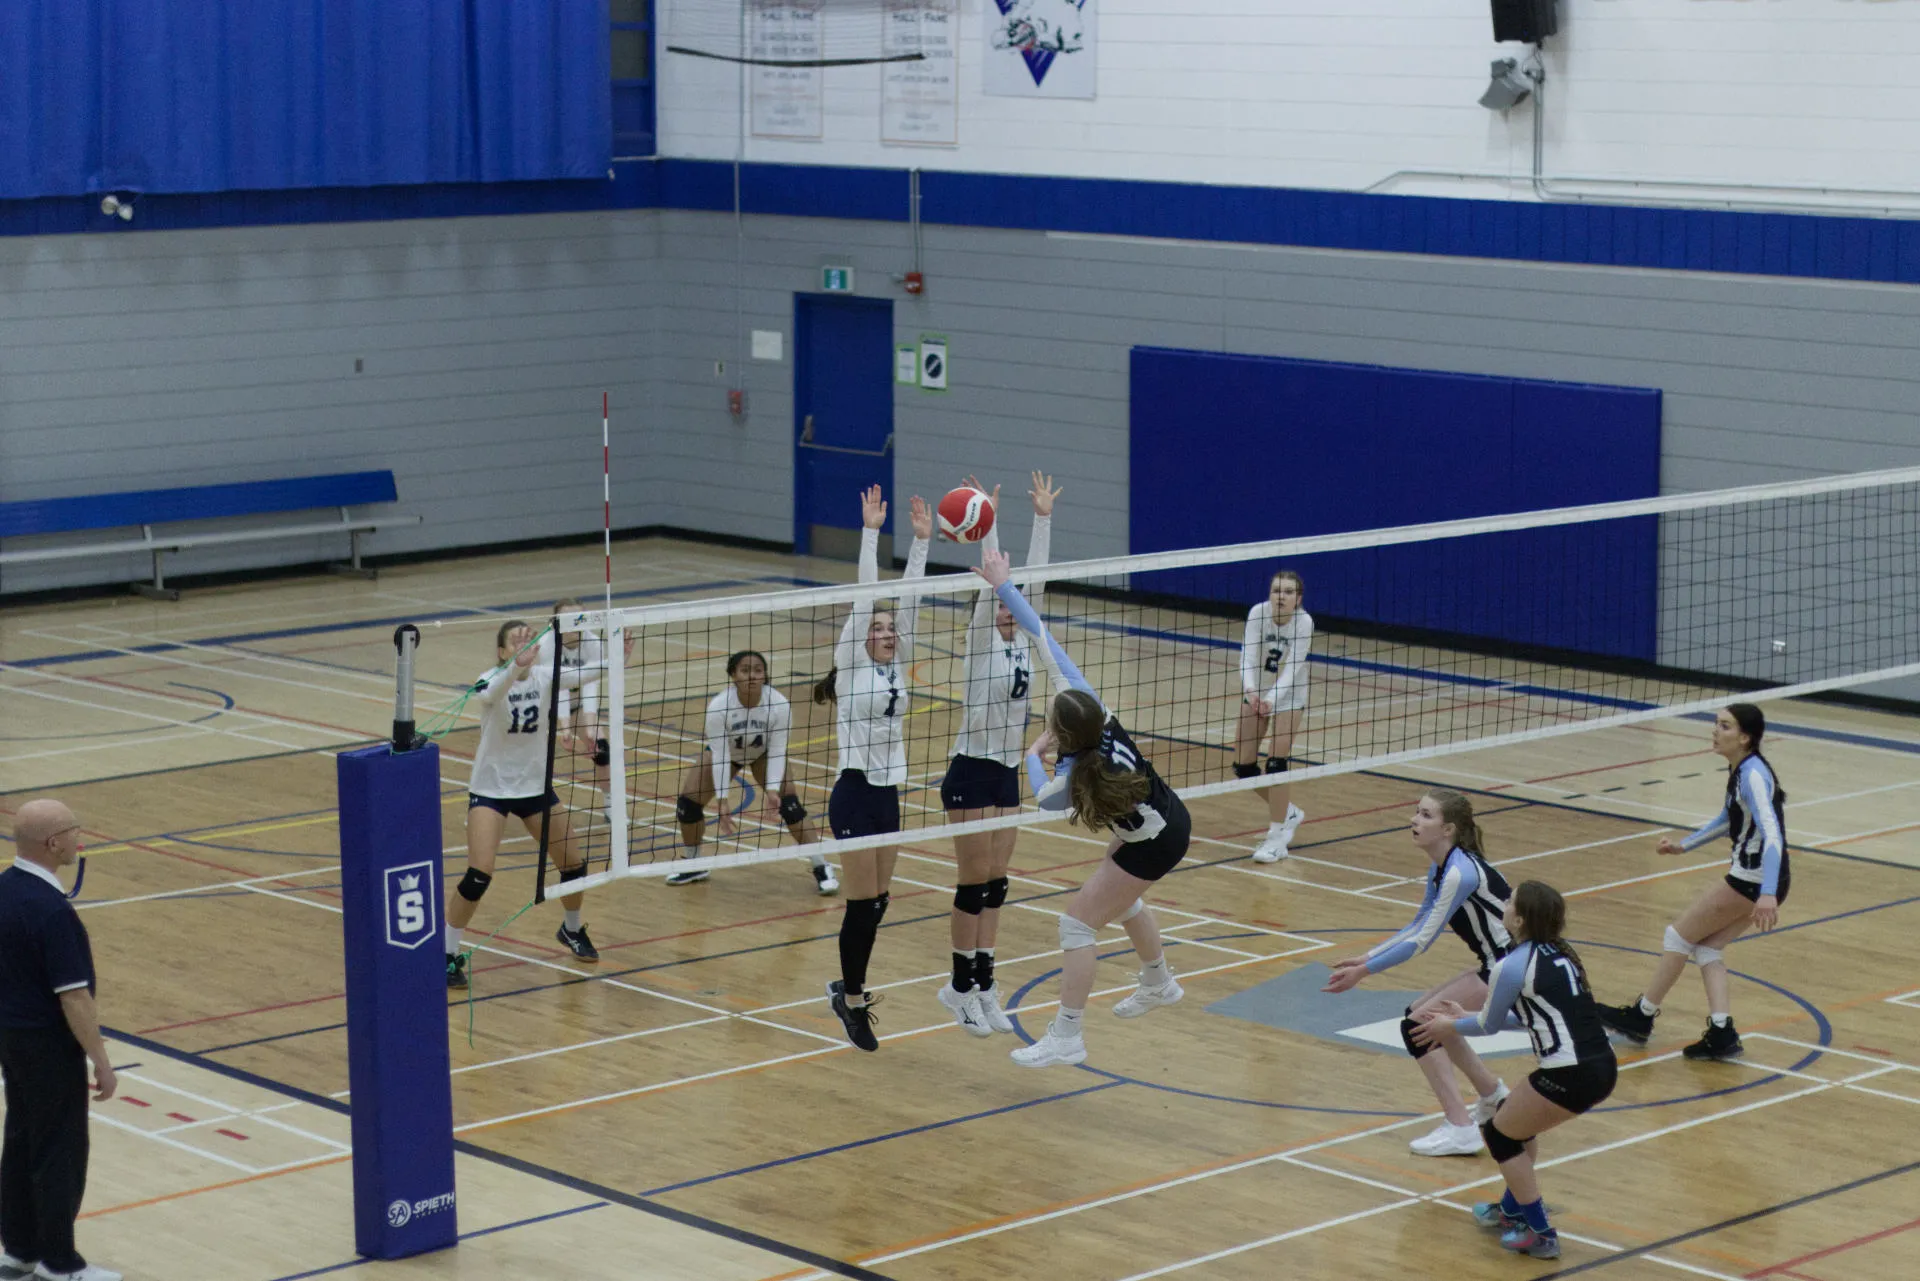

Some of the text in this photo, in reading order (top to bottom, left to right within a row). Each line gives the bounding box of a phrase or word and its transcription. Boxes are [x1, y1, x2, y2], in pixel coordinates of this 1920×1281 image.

[1264, 648, 1283, 673] 2
[1010, 666, 1029, 699] 6
[507, 704, 539, 734] 12
[734, 733, 764, 750] 14
[397, 890, 425, 934] S
[413, 1191, 456, 1215] SPIETH
